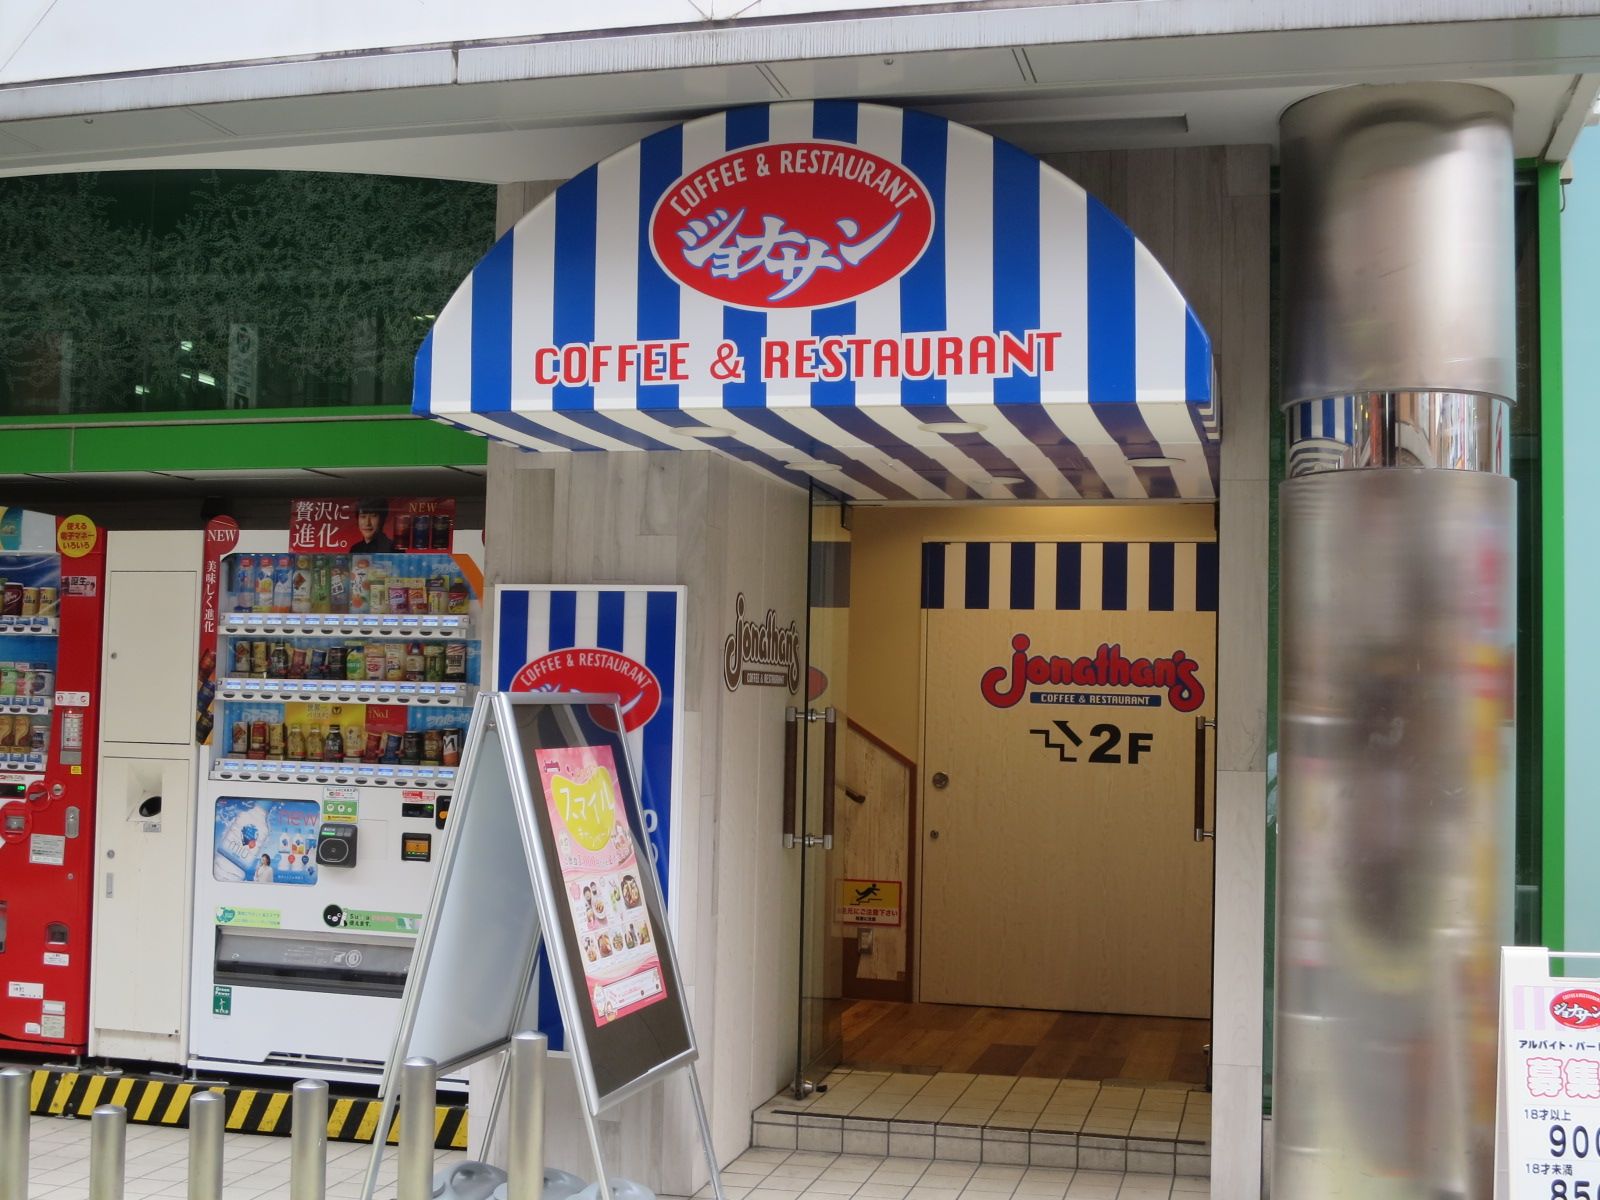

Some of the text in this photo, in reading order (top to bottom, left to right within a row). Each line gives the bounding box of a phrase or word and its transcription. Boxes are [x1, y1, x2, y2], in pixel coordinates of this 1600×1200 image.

[670, 149, 918, 217] COFFEE & RESTAURANT
[677, 207, 902, 302] ジョナサン
[534, 331, 1063, 385] COFFEE & RESTAURANT
[295, 501, 350, 522] 贅沢に
[408, 502, 437, 513] NEW
[62, 541, 90, 550] いろいろ
[207, 529, 236, 542] NEW
[292, 523, 348, 549] 進化。
[204, 560, 218, 633] 美味しく進化
[519, 652, 653, 689] COFFEE & RESTAURANT
[1040, 693, 1151, 706] COFFEE & RESTAURANT
[1088, 723, 1154, 765] 2F
[1519, 1039, 1600, 1051] アルバイト・パー
[1524, 1109, 1571, 1121] 18才以上
[1549, 1124, 1600, 1158] 90
[1526, 1163, 1573, 1176] 18才未満
[1550, 1179, 1600, 1200] 85
